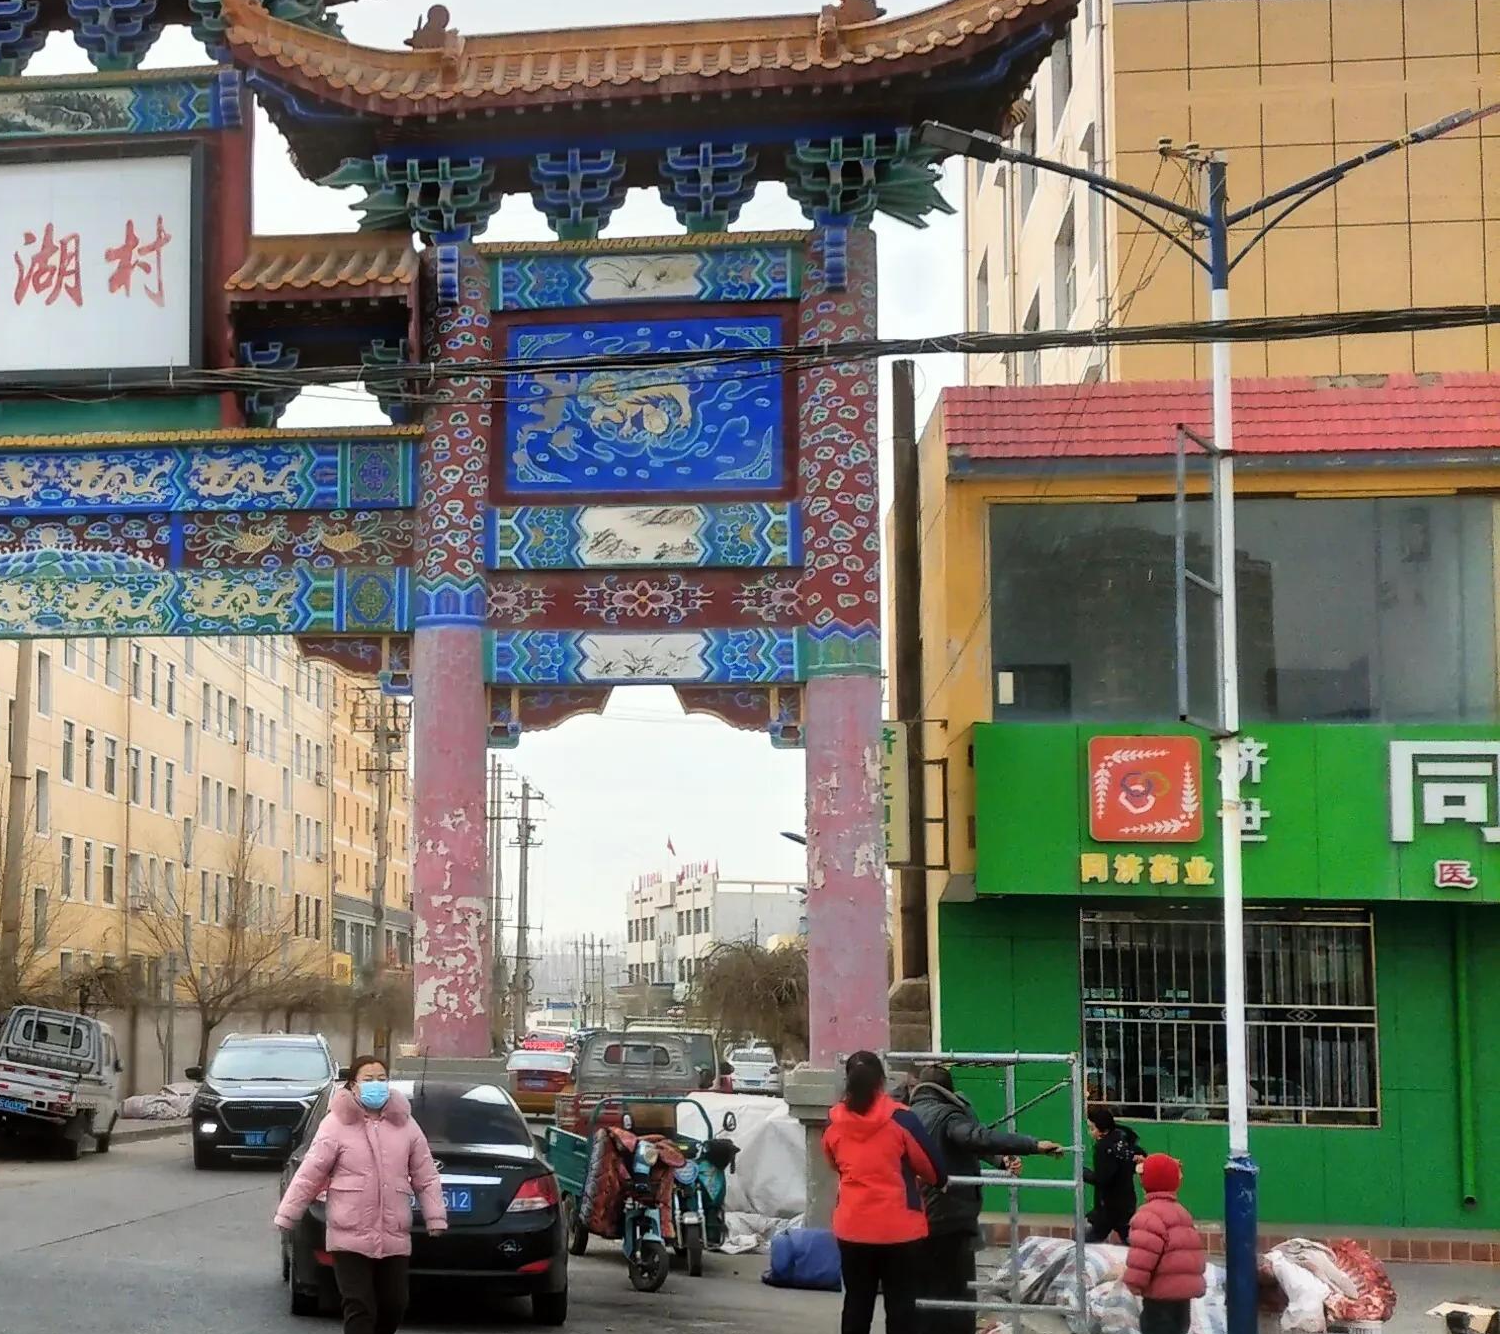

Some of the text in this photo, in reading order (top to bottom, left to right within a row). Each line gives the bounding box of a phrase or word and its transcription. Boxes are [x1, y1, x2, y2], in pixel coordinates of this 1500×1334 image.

[1081, 853, 1215, 885] 同济药业
[1436, 861, 1478, 888] 医
